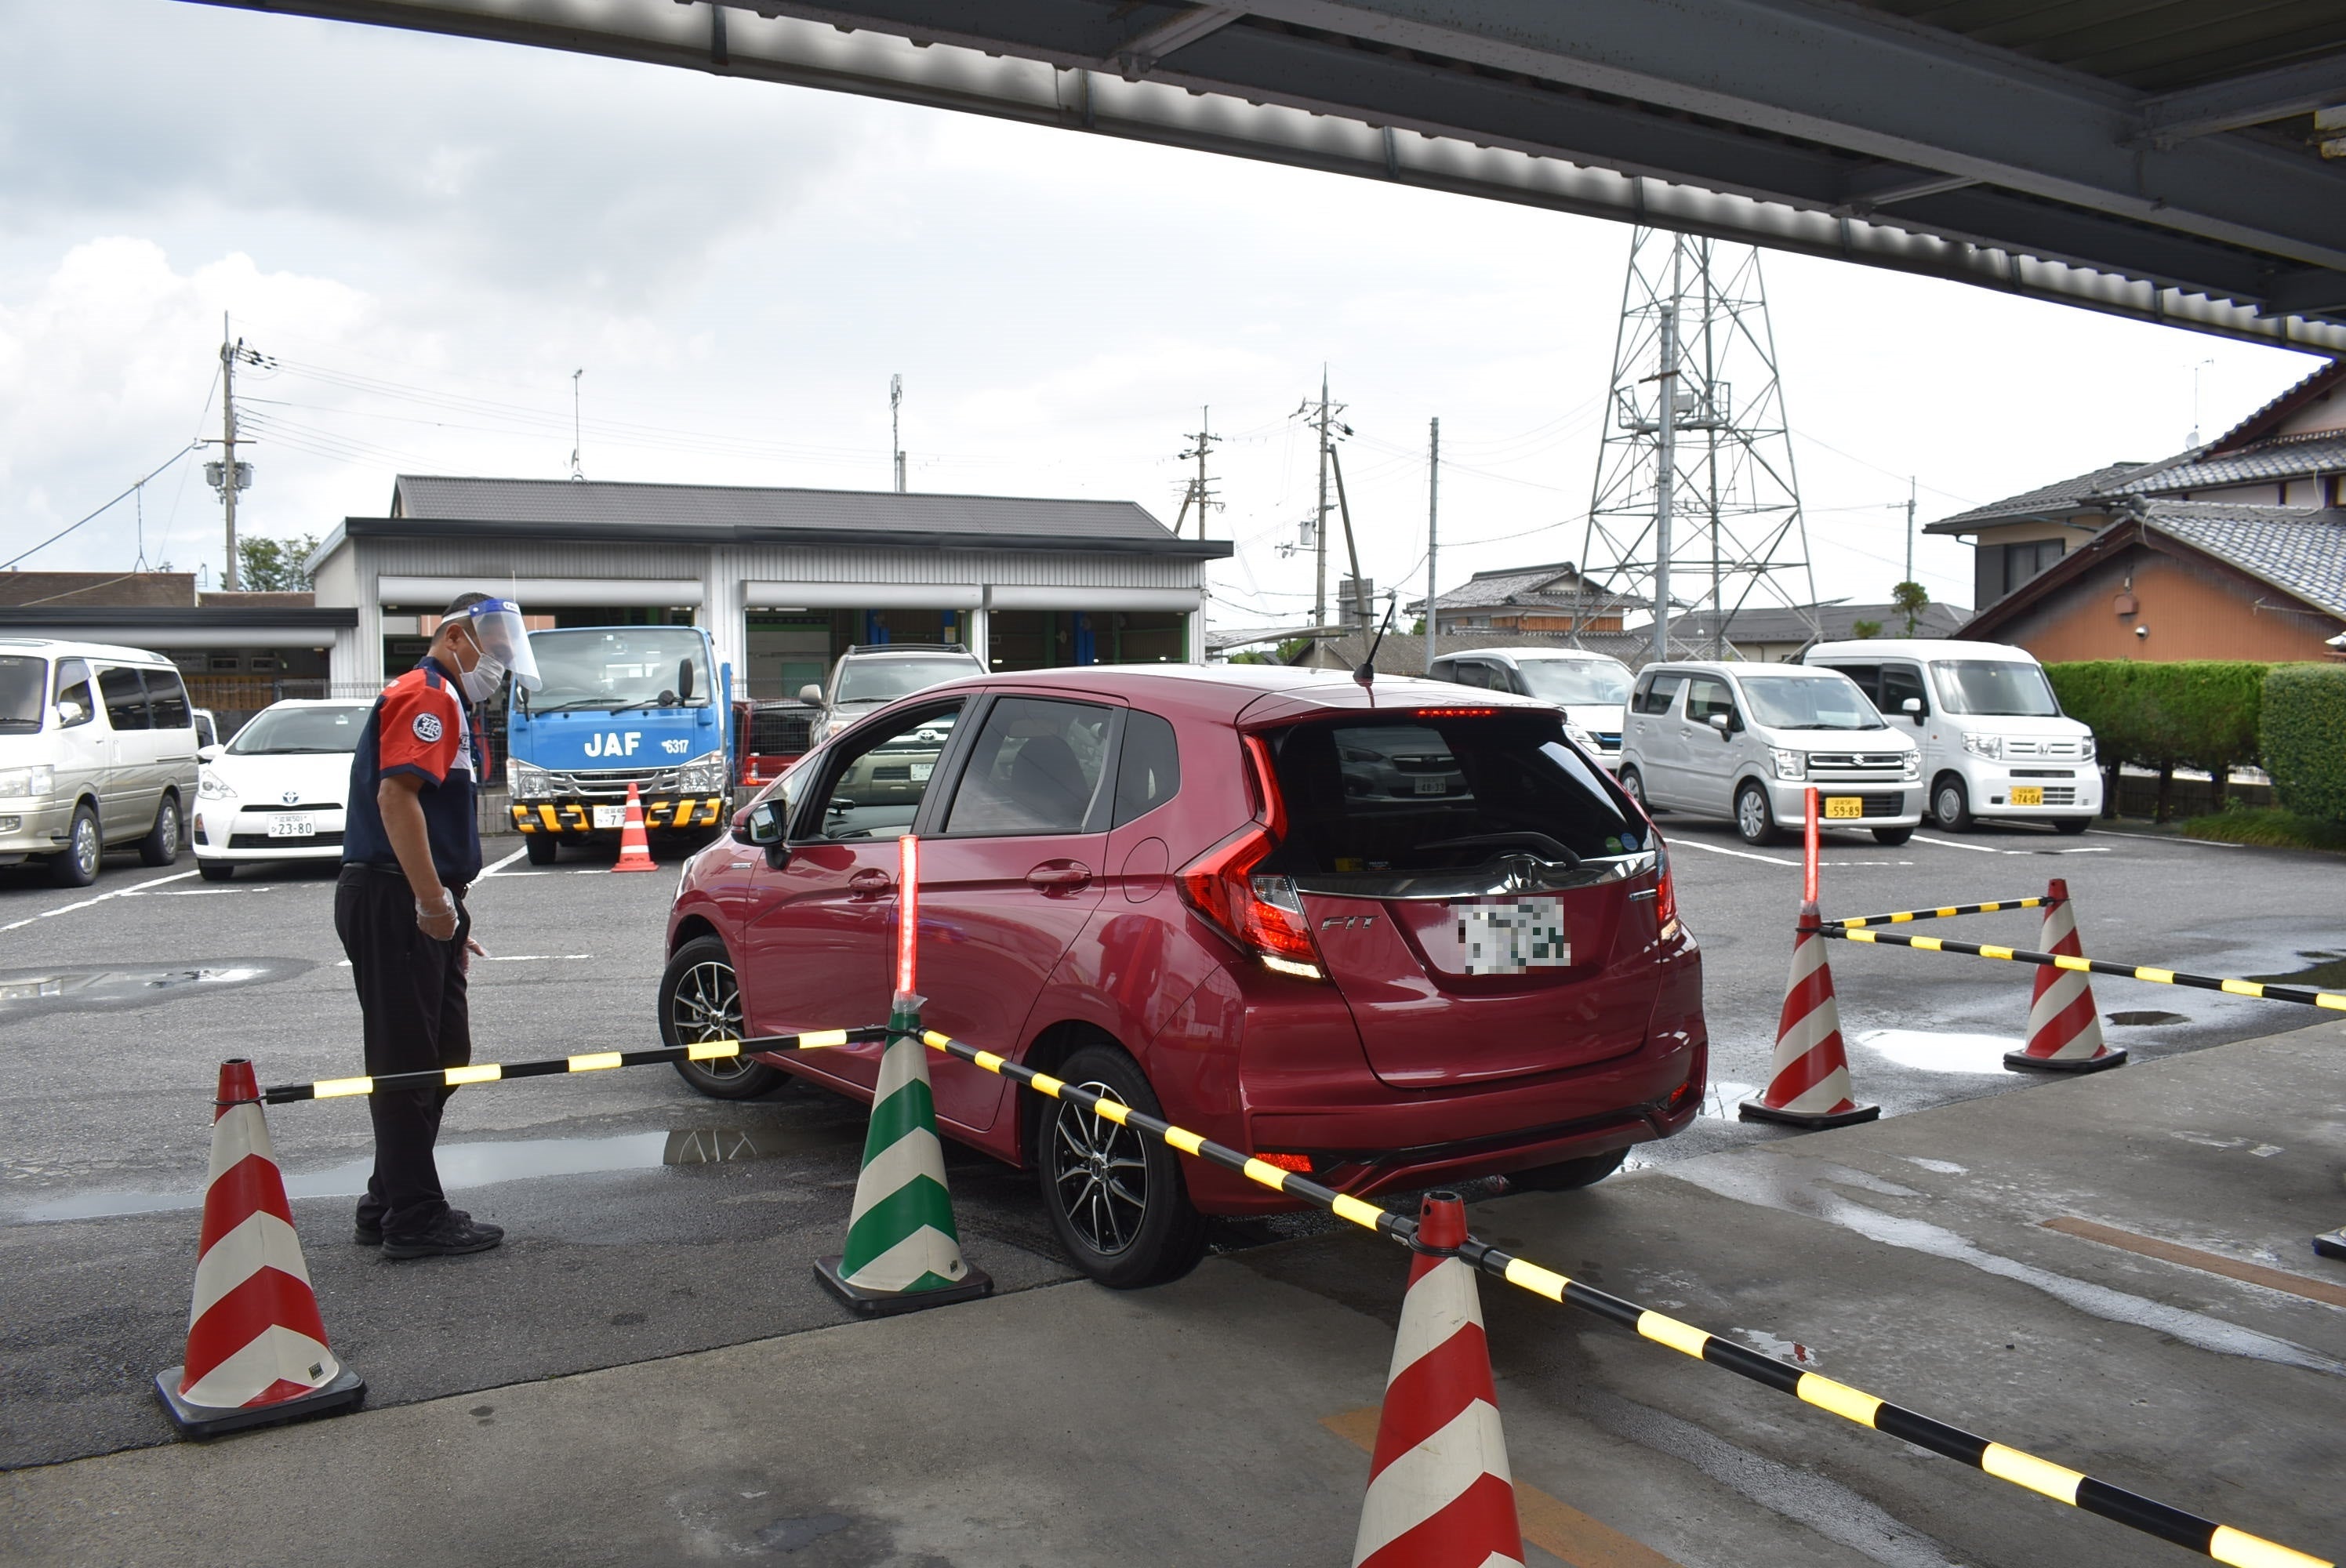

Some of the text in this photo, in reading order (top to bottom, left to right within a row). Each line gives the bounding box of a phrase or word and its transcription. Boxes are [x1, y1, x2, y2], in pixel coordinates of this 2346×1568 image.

[584, 731, 641, 757] JAF
[1833, 806, 1860, 816] 59-89
[278, 822, 312, 835] 23-80
[1320, 916, 1381, 931] FIT
